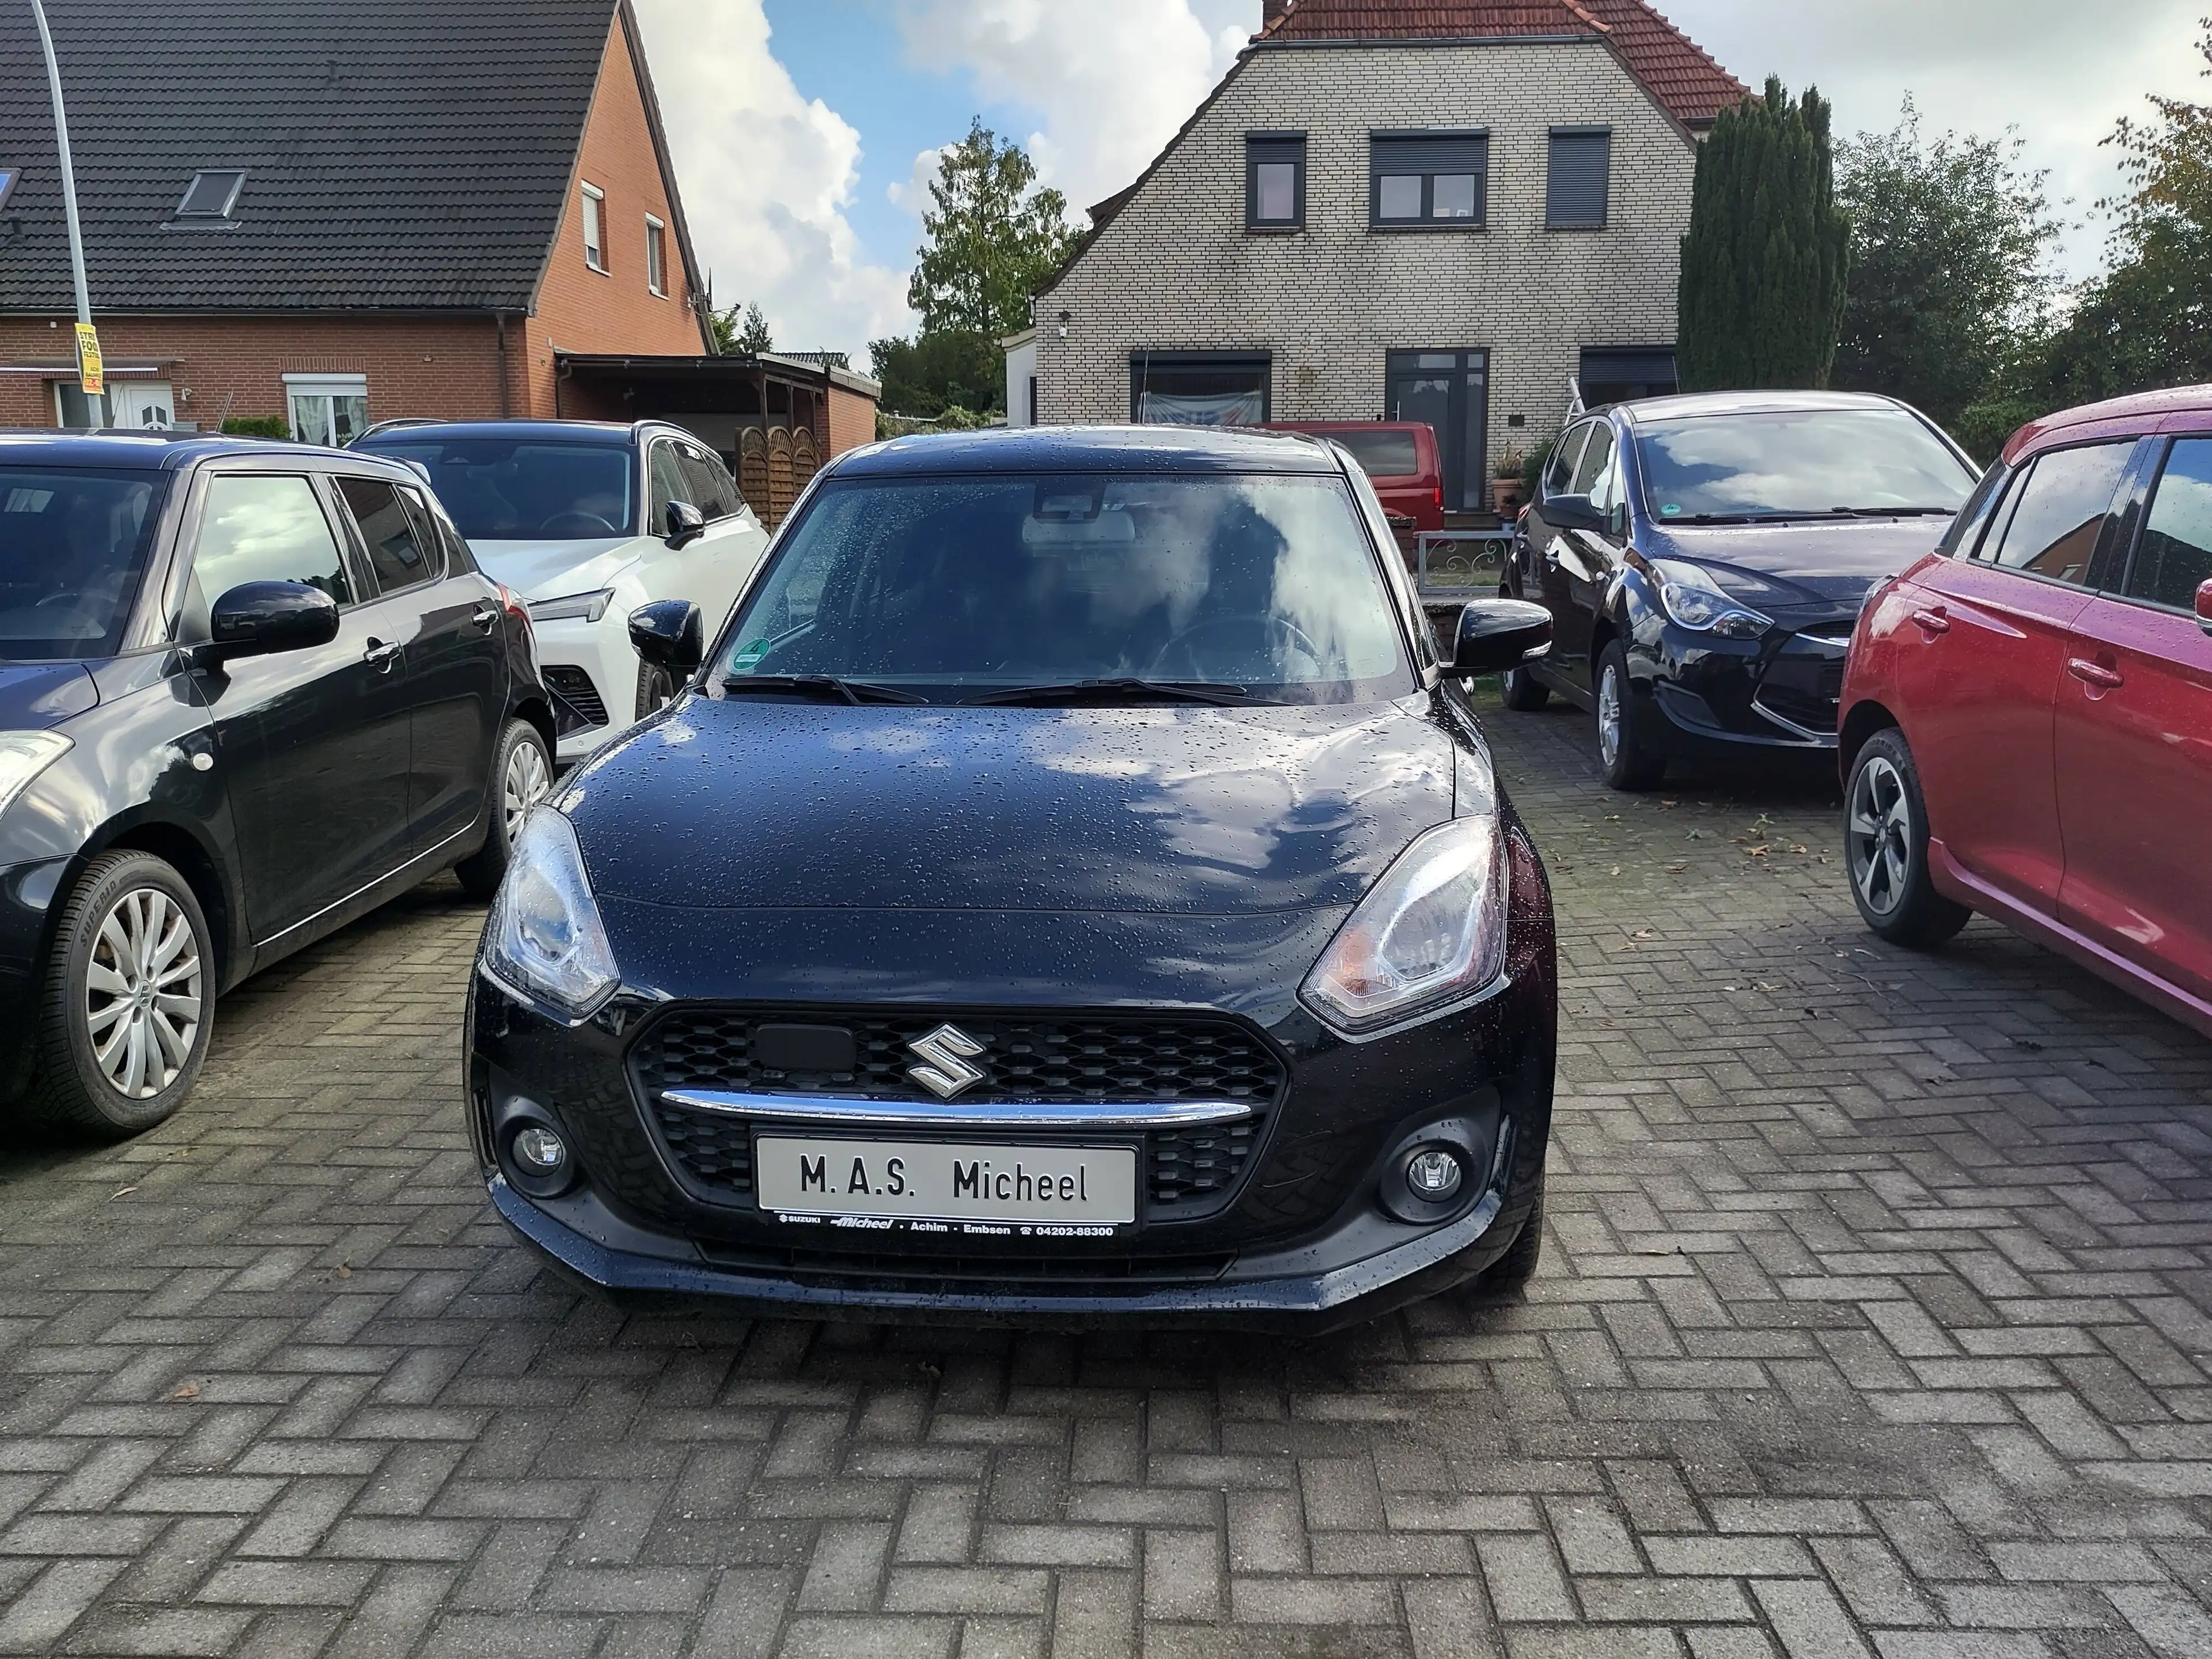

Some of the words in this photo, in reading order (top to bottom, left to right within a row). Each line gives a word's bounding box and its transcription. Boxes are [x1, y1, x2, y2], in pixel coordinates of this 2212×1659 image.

[749, 640, 763, 654] 4
[80, 880, 117, 948] SUPERIA
[953, 1160, 1088, 1202] Micheel
[789, 1215, 821, 1224] SUZUKI
[910, 1221, 948, 1232] Achim
[963, 1224, 1011, 1234] Embsen
[1036, 1226, 1113, 1236] 04202-88300
